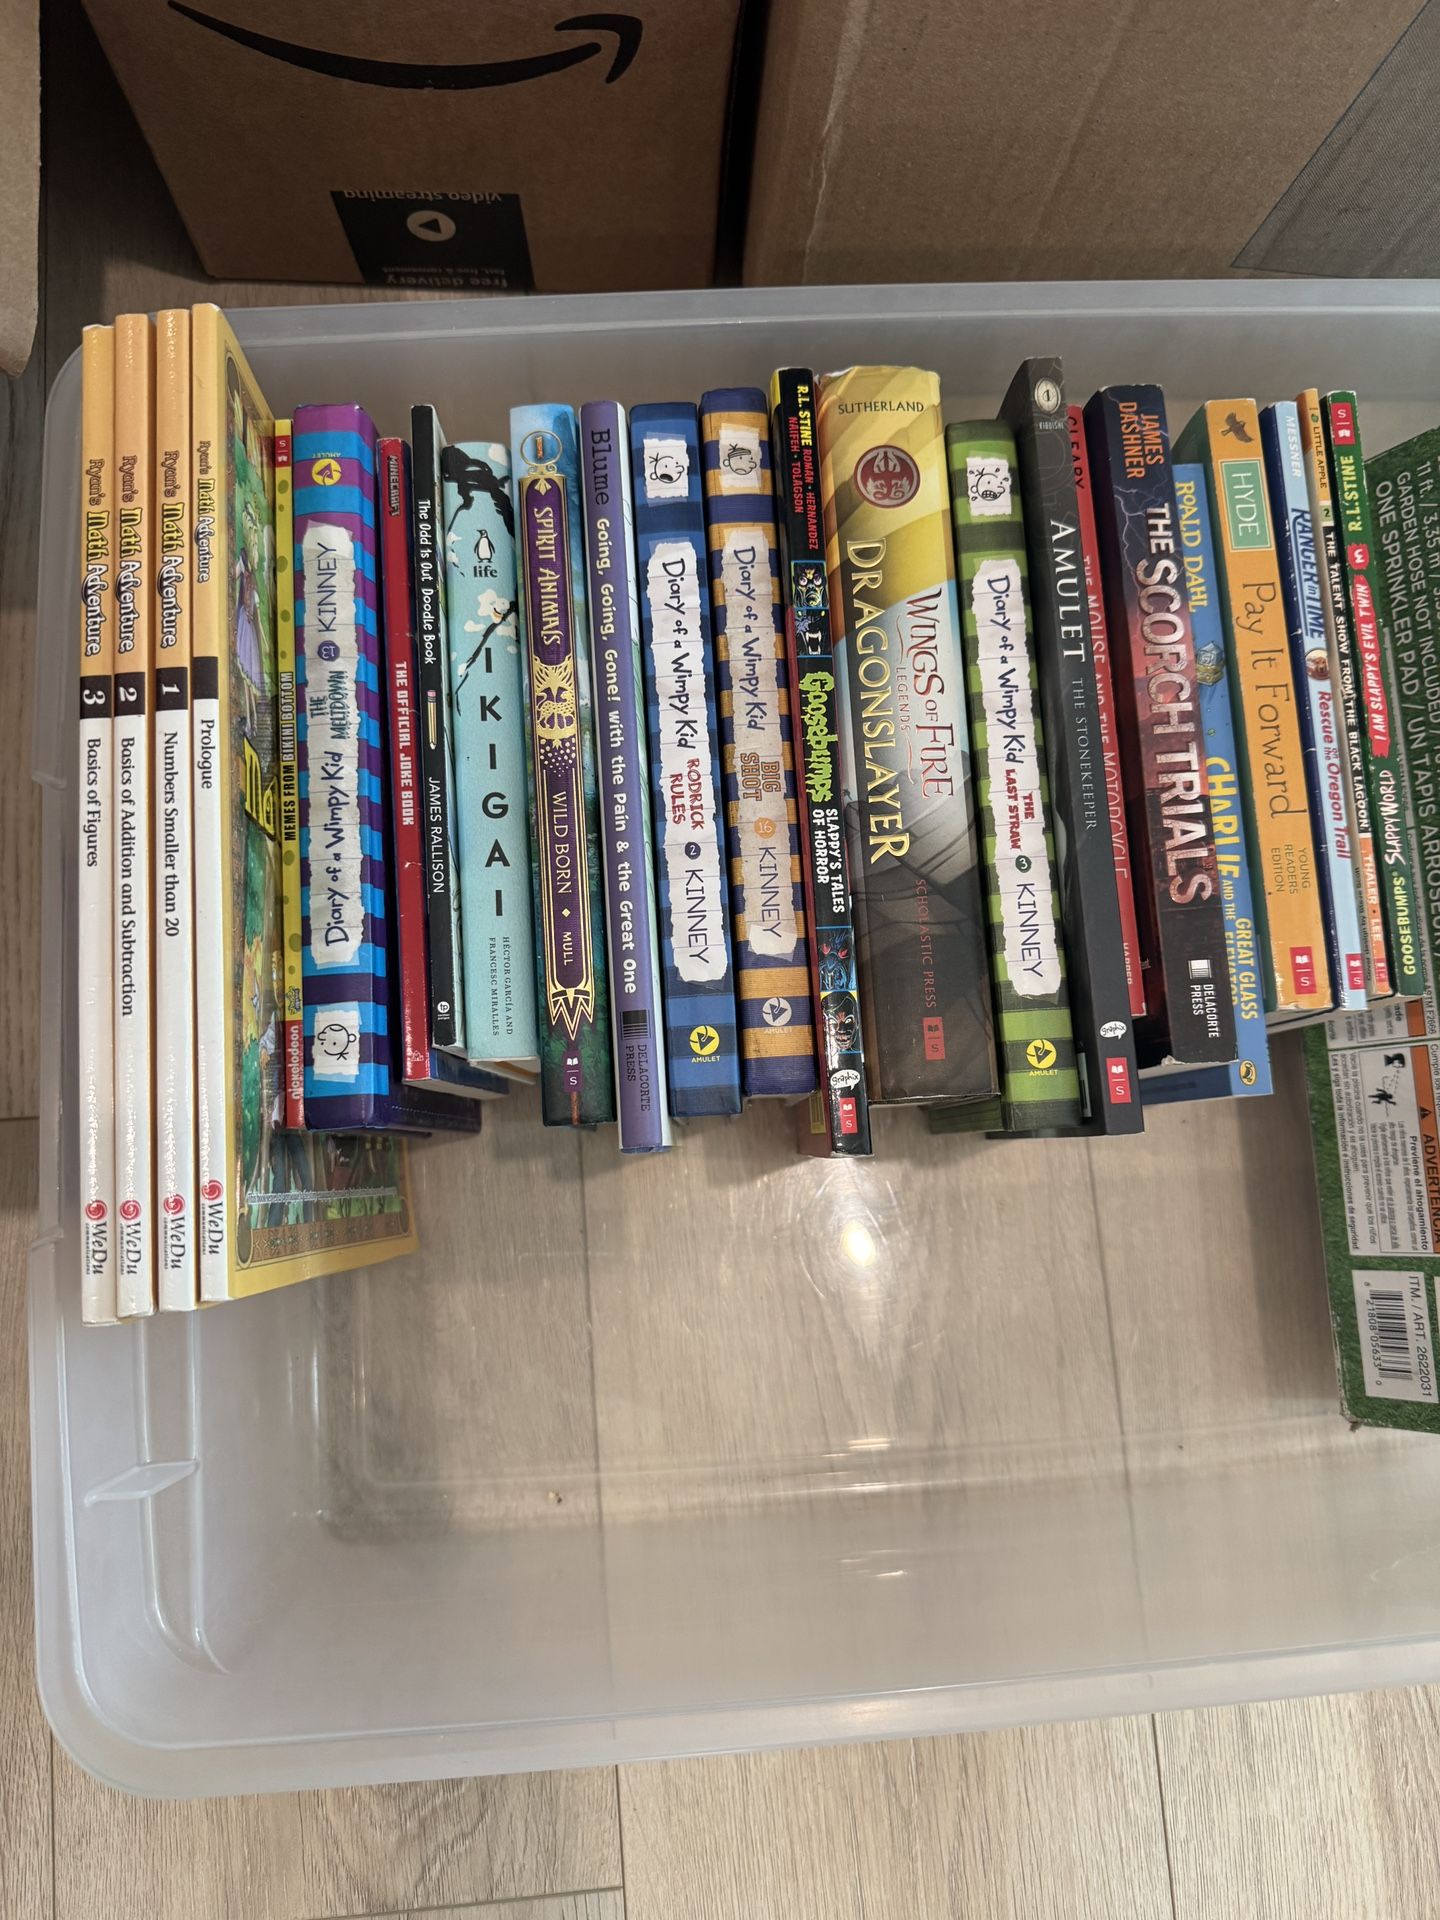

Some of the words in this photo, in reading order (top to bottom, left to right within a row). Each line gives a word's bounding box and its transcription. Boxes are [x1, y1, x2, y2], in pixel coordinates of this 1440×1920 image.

[448, 191, 502, 204] video
[798, 410, 812, 446] STINE
[838, 400, 925, 415] SUTHERLAND
[789, 416, 800, 452] NAIFEH
[1119, 402, 1146, 479] DASHNER
[1140, 414, 1165, 465] JAMES
[1285, 415, 1301, 478] MESSNER
[1313, 426, 1324, 457] LITTLE
[89, 458, 105, 506] Ryan's
[388, 455, 400, 517] MINECRAFT
[591, 428, 612, 505] Blume
[802, 448, 814, 483] ROMAN
[1317, 459, 1327, 488] APPLE
[806, 491, 819, 550] HERNANDEZ
[1175, 480, 1201, 548] ROALD
[1231, 472, 1260, 536] HYDE
[1376, 480, 1396, 528] ONE
[1396, 471, 1417, 542] GARDEN
[86, 511, 110, 560] Math
[419, 523, 432, 545] Odd
[534, 507, 559, 562] SPIRIT
[596, 518, 612, 575] Going,
[317, 542, 337, 632] KINNEY
[421, 562, 433, 581] Out
[474, 565, 498, 578] life
[1050, 519, 1085, 662] AMULET
[1183, 555, 1208, 613] DAHL
[1292, 508, 1317, 583] RANGER
[1307, 596, 1325, 639] TIME
[1330, 563, 1344, 611] TALENT
[1381, 529, 1413, 646] SPRINKLER
[1404, 544, 1425, 591] HOSE
[82, 564, 109, 656] Adventure
[422, 588, 435, 631] Doodle
[537, 567, 564, 647] ANIMALS
[1235, 582, 1276, 635] Pay
[1356, 584, 1371, 616] TWIN
[1413, 595, 1431, 630] NOT
[321, 646, 336, 659] 13
[906, 587, 945, 696] WINGS
[1135, 559, 1195, 735] SCORCH
[1251, 649, 1284, 669] It
[1335, 616, 1349, 654] SHOW
[1361, 623, 1376, 649] EVIL
[280, 671, 293, 720] BOTTOM
[395, 661, 408, 687] THE
[604, 649, 621, 702] Gone!
[1341, 659, 1354, 695] FROM
[1398, 650, 1420, 696] PAD
[1419, 636, 1440, 724] INCLUDED
[328, 670, 351, 740] MELTDOWN
[397, 690, 411, 749] OFFICIAL
[847, 538, 911, 864] DRAGONSLAYER
[895, 667, 911, 732] LEGENDS
[1318, 691, 1333, 743] Rescue
[1372, 714, 1386, 732] AM
[282, 722, 294, 761] BIKINI
[608, 710, 624, 748] with
[675, 720, 698, 750] Kid
[799, 671, 839, 803] Goosebumps
[1255, 683, 1307, 819] Forward
[1349, 731, 1361, 771] BLACK
[1407, 717, 1429, 750] UN
[87, 738, 101, 784] Basics
[164, 731, 179, 804] Numbers
[197, 718, 215, 789] Prologue
[321, 751, 344, 781] Kid
[400, 752, 413, 787] JOKE
[740, 752, 762, 801] SHOT
[761, 760, 781, 793] BIG
[915, 722, 955, 798] FIRE
[1076, 718, 1097, 830] STONEKEEPER
[87, 789, 101, 806] of
[283, 765, 295, 797] FROM
[428, 777, 441, 821] JAMES
[669, 773, 686, 825] RULES
[687, 758, 705, 830] RODRICK
[1004, 769, 1018, 802] LAST
[1327, 763, 1346, 821] Oregon
[1355, 775, 1369, 829] LAGOON
[1413, 754, 1436, 817] TAPIS
[285, 799, 296, 841] MEMES
[324, 786, 350, 849] Wimpy
[401, 791, 414, 826] BOOK
[552, 791, 568, 838] WILD
[614, 793, 629, 832] Pain
[759, 821, 772, 833] 16
[1007, 804, 1021, 851] STRAW
[1156, 741, 1213, 904] TRIALS
[83, 807, 101, 867] Figures
[121, 807, 136, 879] Addition
[164, 808, 181, 870] Smaller
[431, 827, 444, 893] RALLISON
[813, 830, 829, 884] HORROR
[826, 808, 842, 870] SLAPPY'S
[1334, 825, 1351, 859] Trail
[555, 843, 572, 894] BORN
[1222, 880, 1235, 901] AND
[1271, 848, 1284, 893] EDITION
[1284, 844, 1298, 895] READERS
[1298, 847, 1311, 889] YOUNG
[1363, 855, 1378, 905] THALER
[121, 884, 136, 916] and
[165, 875, 179, 913] than
[325, 888, 349, 946] Diary
[685, 869, 709, 964] KINNEY
[830, 874, 845, 914] TALES
[165, 918, 180, 937] 20
[620, 900, 634, 951] Great
[914, 879, 934, 966] SCHOLASTIC
[1235, 918, 1255, 970] GREAT
[1370, 918, 1381, 941] LEE
[1393, 877, 1416, 975] GOOSEBUMPS
[121, 920, 137, 1016] Subtraction
[489, 937, 498, 985] FRANCESC
[562, 931, 574, 965] MULL
[622, 959, 636, 994] One
[923, 970, 937, 1008] PRESS
[1238, 971, 1259, 1020] GLASS
[491, 988, 499, 1036] MIRALLES
[1101, 1024, 1125, 1036] graphix
[1203, 984, 1220, 1038] DELACORTE
[1428, 1011, 1436, 1034] F2666
[287, 1025, 299, 1100] nickelodeon
[626, 1045, 636, 1082] PRESS
[637, 1043, 651, 1112] DELACORTE
[691, 1055, 721, 1063] AMULET
[832, 1073, 859, 1086] graphix
[1028, 1068, 1058, 1076] AMULET
[1410, 1136, 1420, 1176] Previene
[1415, 1189, 1428, 1250] ahogamiento
[1423, 1134, 1440, 1244] ADVERTENCIA
[92, 1221, 107, 1275] WeDu
[1408, 1276, 1421, 1301] ITM.
[1365, 1299, 1377, 1331] 21808
[1412, 1312, 1426, 1342] ART.
[1370, 1335, 1381, 1368] 05633
[1416, 1346, 1432, 1397] 2622031
